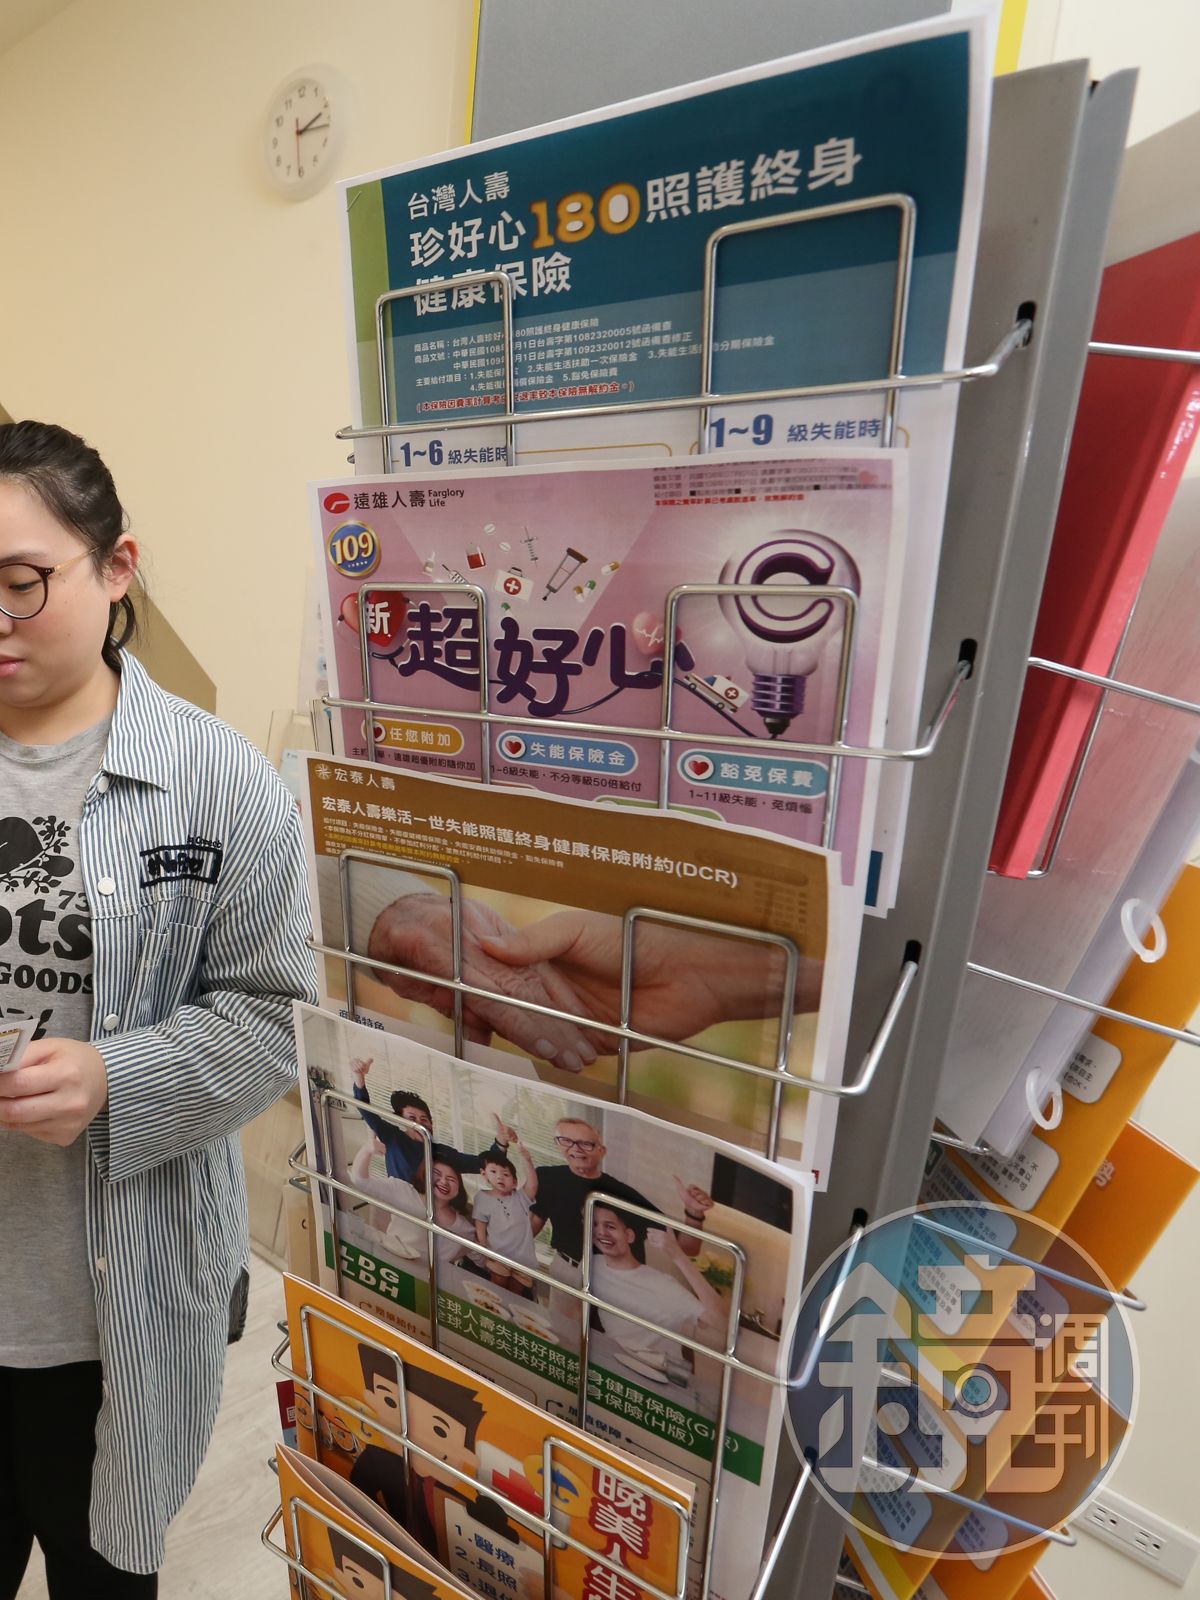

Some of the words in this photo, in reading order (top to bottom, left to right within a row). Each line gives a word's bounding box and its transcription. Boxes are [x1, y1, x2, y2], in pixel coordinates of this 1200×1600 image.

[407, 170, 510, 220] 台灣人壽
[413, 251, 572, 317] 健康保險
[787, 419, 882, 442] 級失能時
[448, 446, 508, 465] 級失能時
[353, 489, 425, 510] 遠雄人壽
[428, 488, 464, 498] Farglory
[428, 498, 446, 508] Life
[332, 531, 374, 565] 109
[366, 601, 391, 635] 新
[390, 727, 451, 747] 任您附加
[530, 742, 626, 767] 失能保險金
[334, 768, 395, 791] 宏泰人壽
[720, 762, 813, 788] 豁免保費
[341, 1245, 400, 1284] LDG
[341, 1260, 399, 1298] LDH
